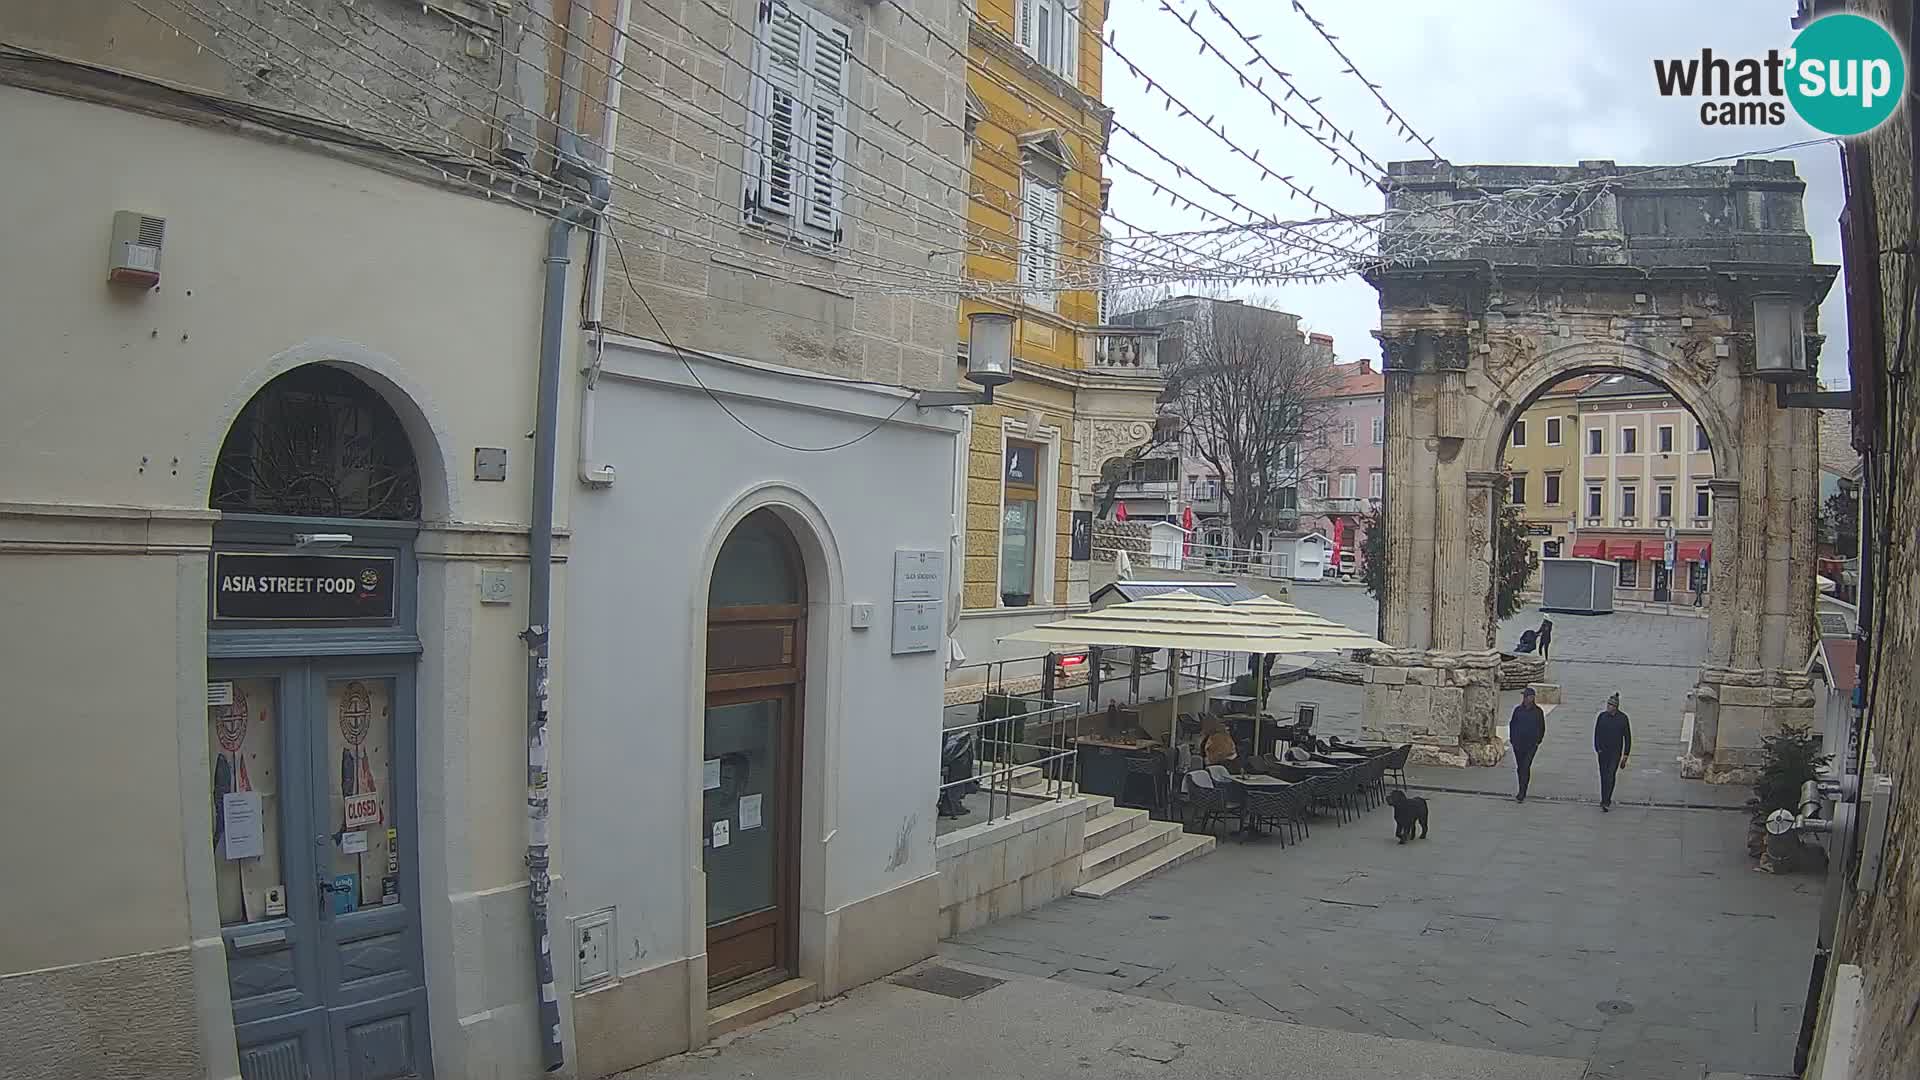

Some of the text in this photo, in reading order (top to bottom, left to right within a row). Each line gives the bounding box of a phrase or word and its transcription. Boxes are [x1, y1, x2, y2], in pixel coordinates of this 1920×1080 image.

[222, 576, 356, 593] ASIA STREET FOOD
[348, 800, 377, 820] CLOSED
